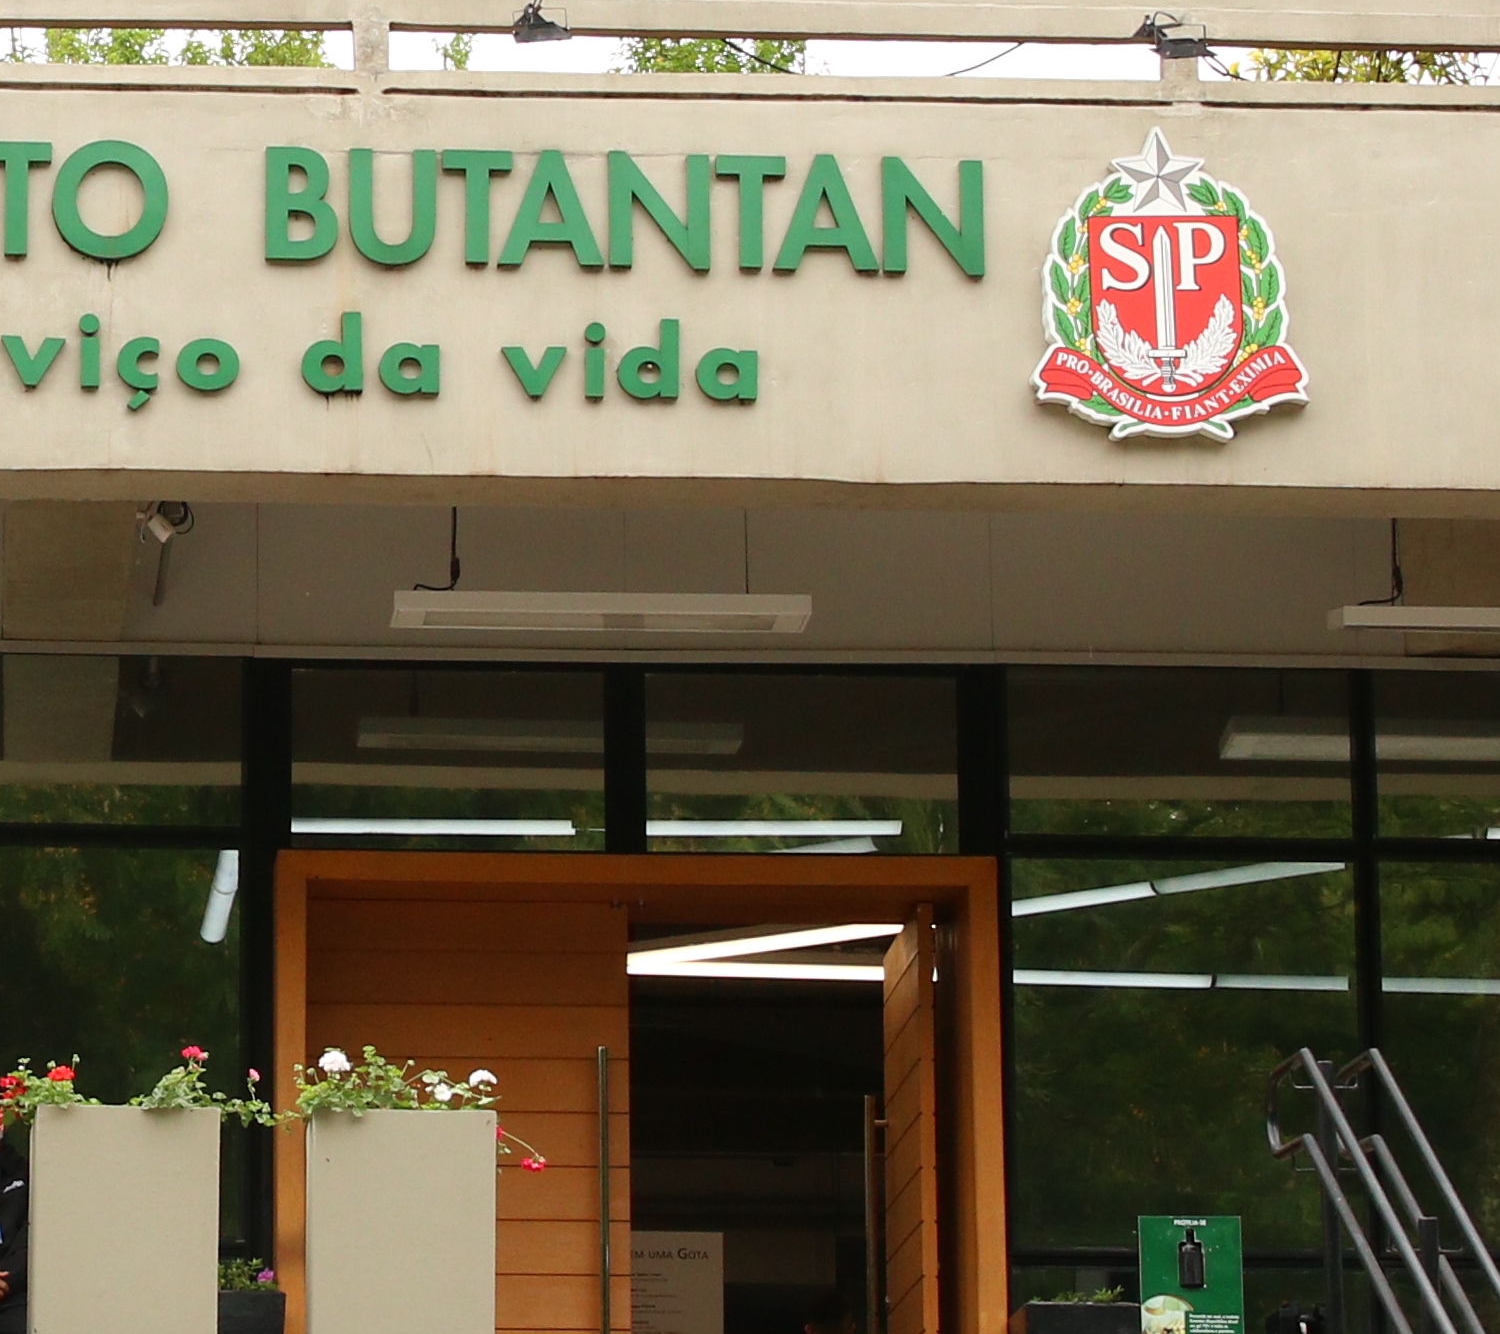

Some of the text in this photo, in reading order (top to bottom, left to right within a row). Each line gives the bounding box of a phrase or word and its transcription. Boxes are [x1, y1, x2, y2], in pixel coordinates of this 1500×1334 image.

[265, 146, 985, 278] BUTANTAN
[302, 311, 440, 397] da
[501, 319, 758, 403] vida
[1056, 350, 1286, 421] PRO BRASILIA FIANT EXIMIA
[648, 1250, 674, 1260] UMA
